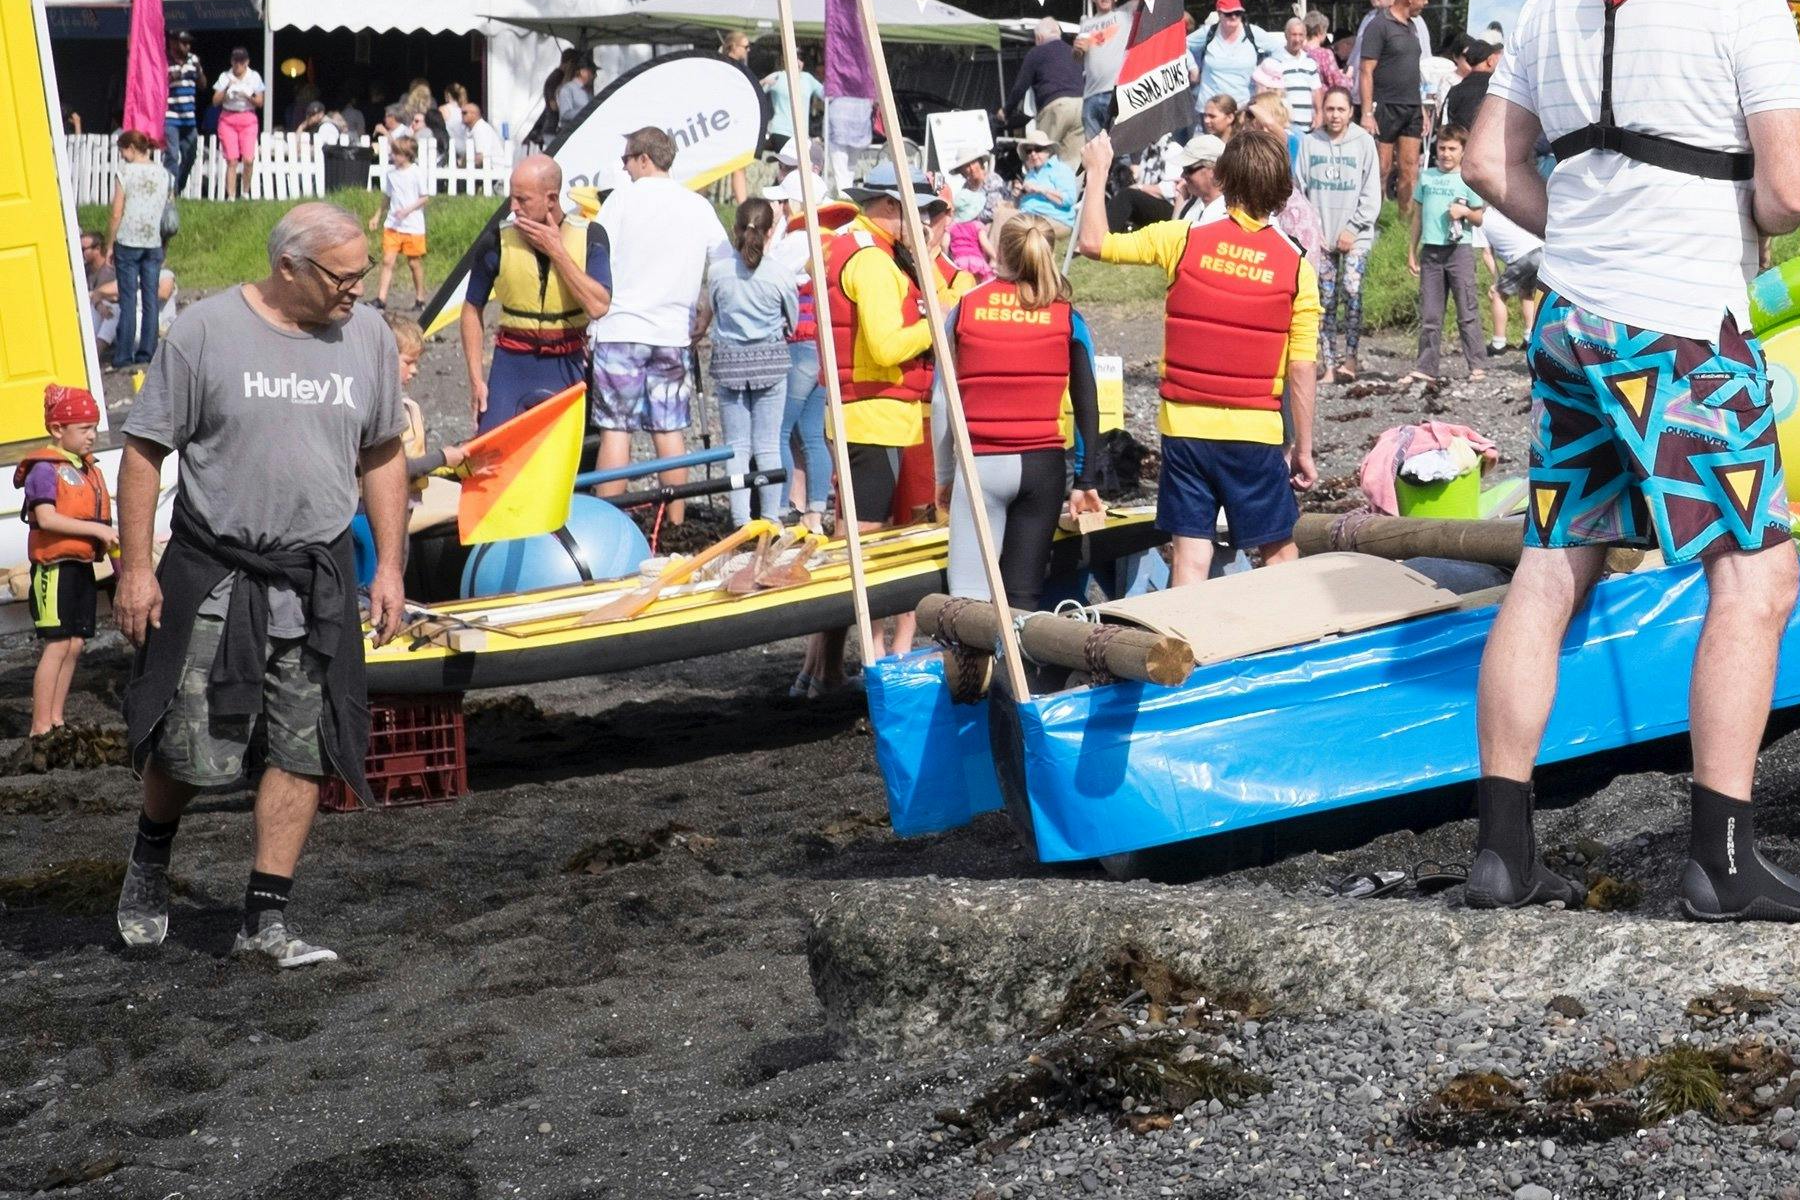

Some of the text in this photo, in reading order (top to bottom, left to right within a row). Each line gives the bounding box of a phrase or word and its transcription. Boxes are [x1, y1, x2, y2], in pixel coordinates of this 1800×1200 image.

[666, 108, 731, 148] hite
[1216, 242, 1268, 265] SURF
[1200, 255, 1275, 285] RESCUE
[988, 292, 1020, 307] SU
[975, 307, 1051, 325] RESCUE
[243, 372, 331, 404] Hurley
[1666, 425, 1730, 451] QUIKSILVER
